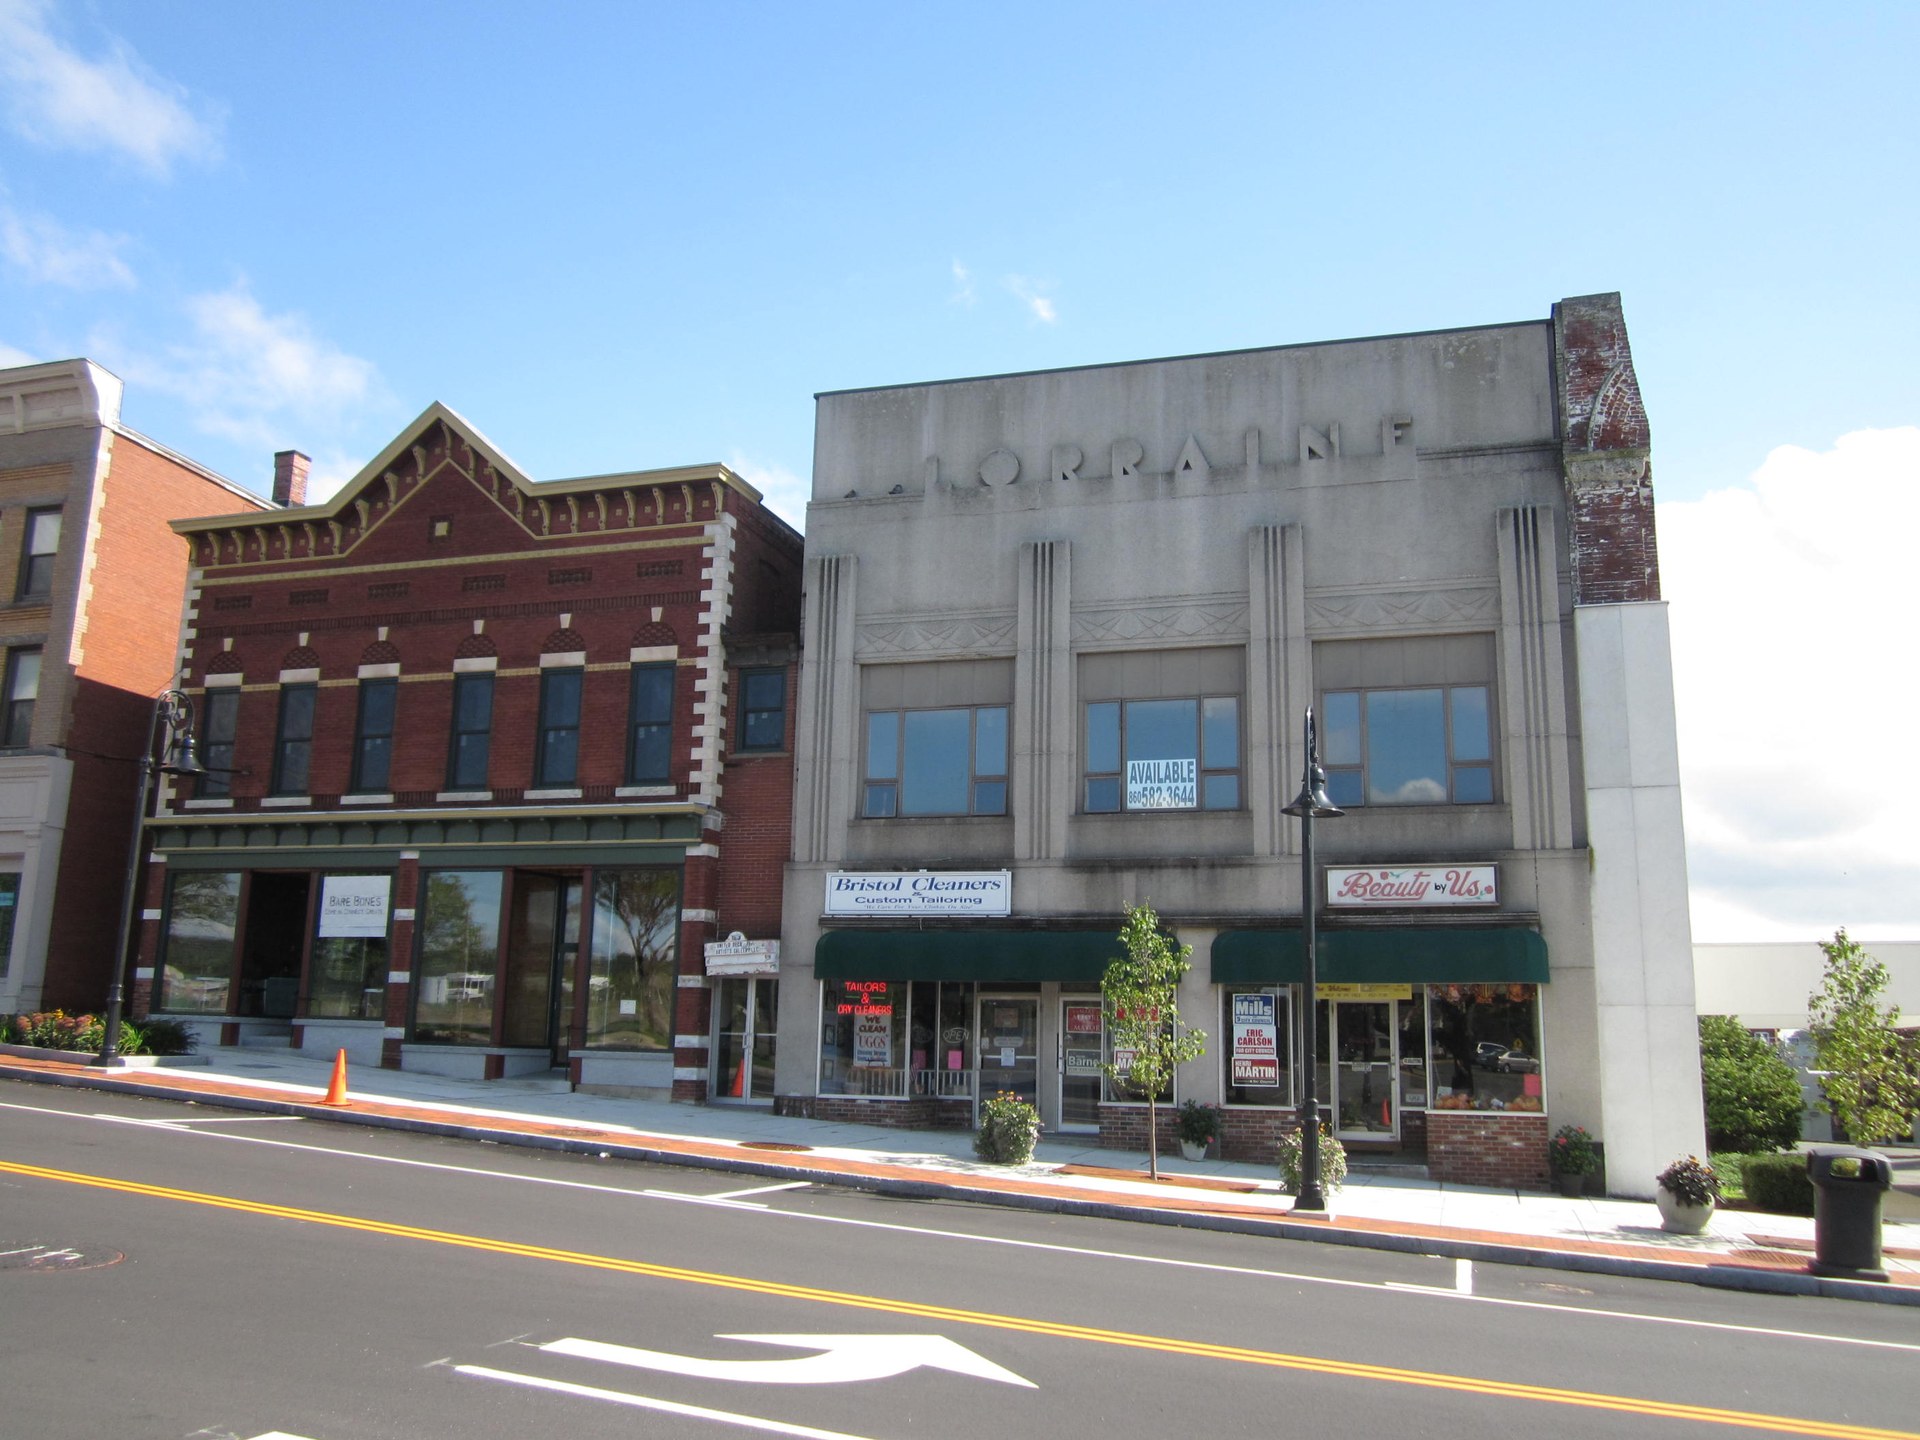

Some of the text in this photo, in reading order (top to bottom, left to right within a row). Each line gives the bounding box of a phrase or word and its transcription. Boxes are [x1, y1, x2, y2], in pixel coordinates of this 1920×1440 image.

[1129, 761, 1195, 785] AVAILABLE
[835, 876, 1001, 892] Bristol Cleaners
[1337, 870, 1481, 901] Beauty by Us
[329, 895, 382, 907] BARE BONES
[855, 895, 982, 905] Custom Tailoring
[845, 981, 887, 993] TAILORS
[861, 992, 870, 1004] &
[837, 1004, 893, 1015] DRY CLEANERS
[1236, 1001, 1272, 1016] Mills
[865, 1015, 881, 1024] WE
[859, 1025, 887, 1033] CLEAN
[942, 1030, 970, 1040] OPEN
[1246, 1029, 1264, 1037] ERIC
[1237, 1037, 1273, 1046] CARLSON
[1235, 1066, 1276, 1078] MARTIN
